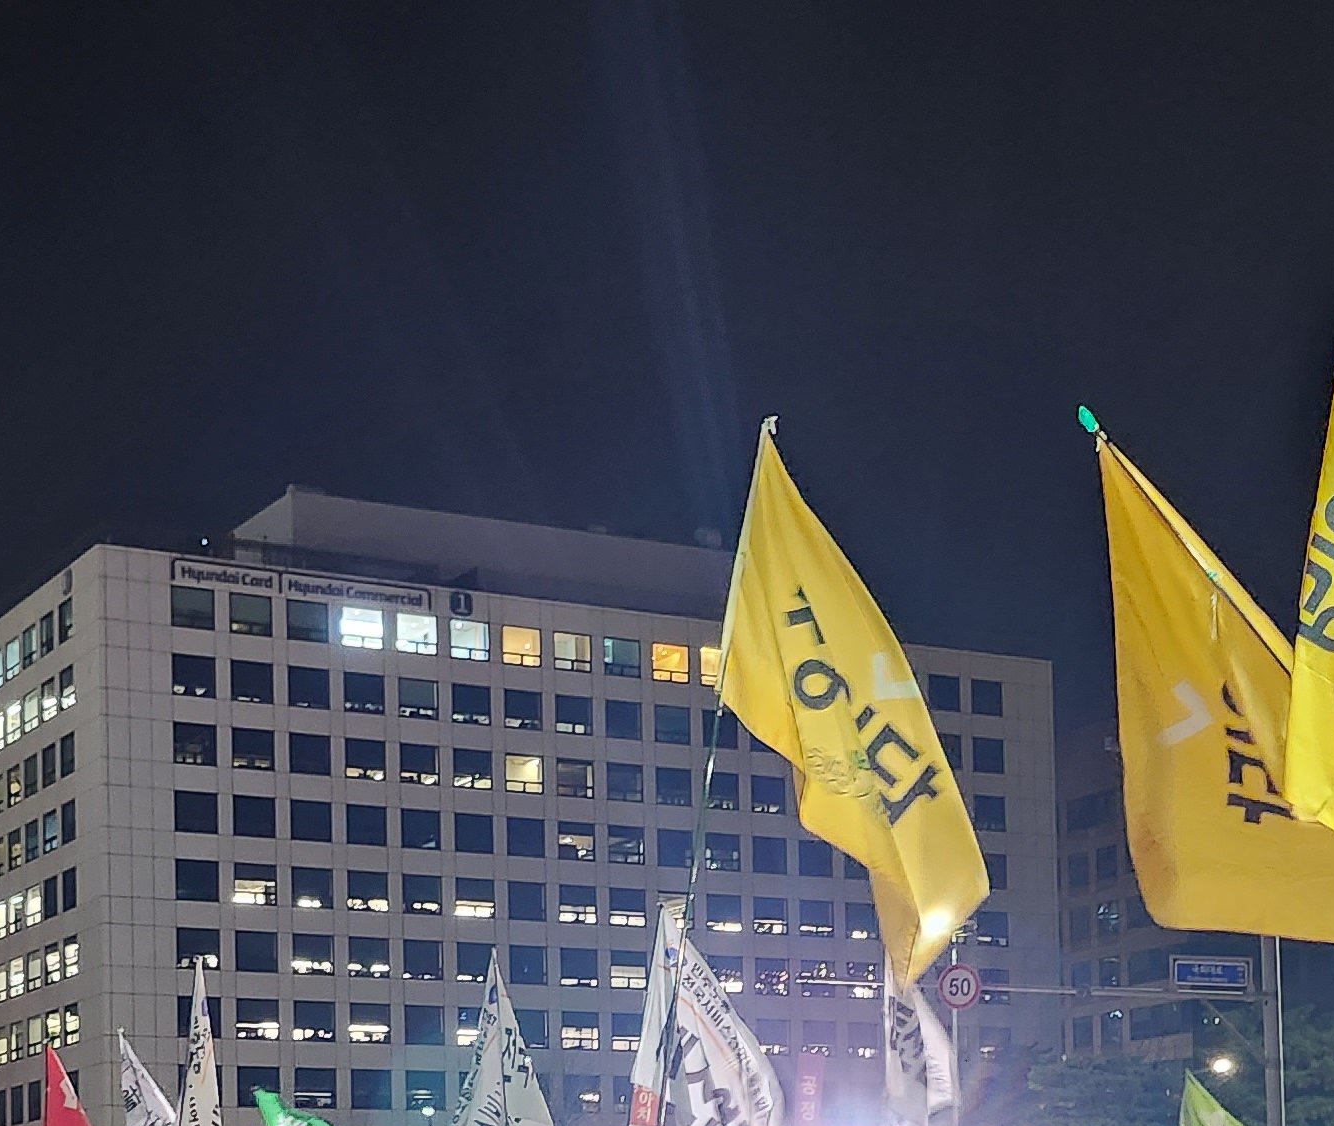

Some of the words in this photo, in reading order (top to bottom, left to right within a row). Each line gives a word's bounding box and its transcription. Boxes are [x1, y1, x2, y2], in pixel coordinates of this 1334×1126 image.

[179, 566, 240, 585] Hyundai
[241, 572, 274, 589] Card
[287, 578, 345, 597] Hyundai
[346, 586, 423, 607] Commercial
[948, 976, 972, 998] 50
